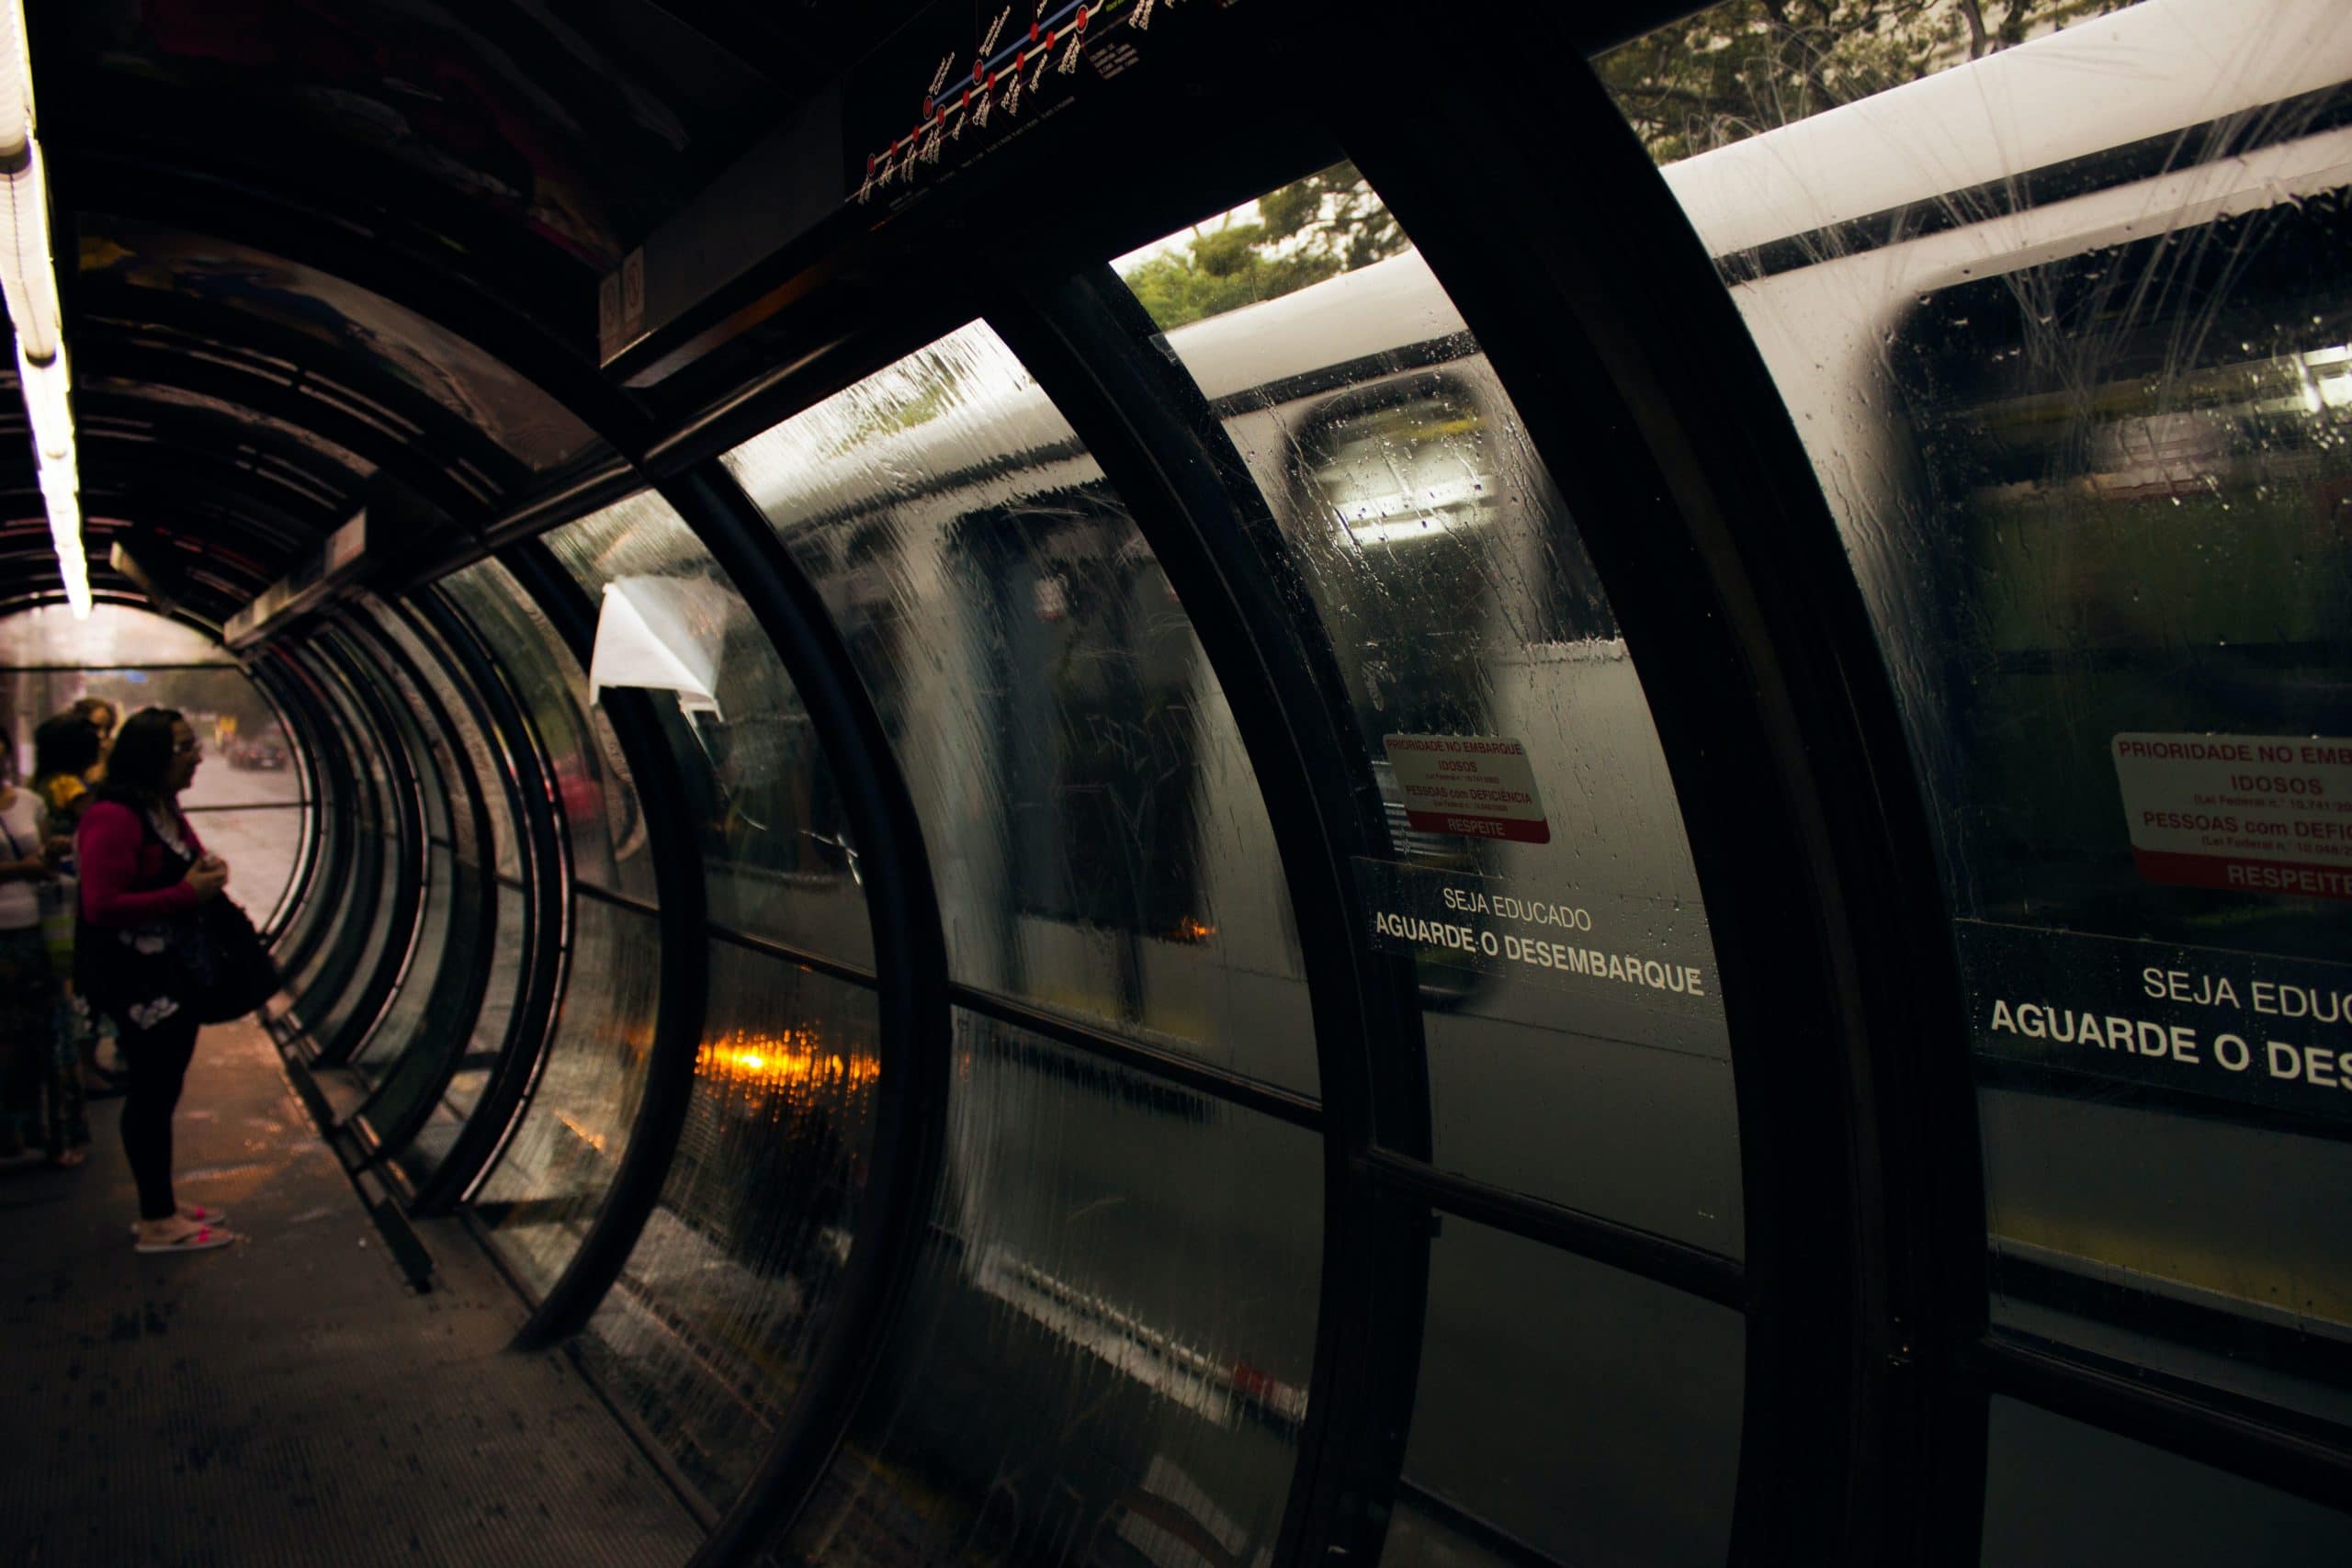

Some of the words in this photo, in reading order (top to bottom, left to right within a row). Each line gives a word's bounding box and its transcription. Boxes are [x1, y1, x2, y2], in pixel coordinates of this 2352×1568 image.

[1386, 739, 1445, 752] PRIORIDADE
[1446, 741, 1461, 753] NO
[1464, 741, 1522, 755] EMBARQUE
[2118, 740, 2253, 762] PRIORIDADE
[2258, 745, 2294, 763] NO
[1438, 760, 1477, 773] IDOSOS
[1405, 784, 1448, 798] PESSOAS
[1449, 789, 1469, 799] com
[2229, 773, 2324, 795] IDOSOS
[1448, 818, 1507, 837] RESPEITE
[2143, 810, 2239, 833] PESSOAS
[2245, 821, 2289, 836] com
[2226, 863, 2352, 897] RESPEITE
[1442, 886, 1490, 915] SEJA
[1493, 896, 1591, 931] EDUCADO
[1375, 911, 1476, 953] AGUARDE
[1481, 931, 1499, 956] O
[1504, 936, 1704, 997] DESEMBARQUE
[2143, 966, 2241, 1010] SEJA
[1990, 999, 2200, 1065] AGUARDE
[2212, 1032, 2251, 1072] O
